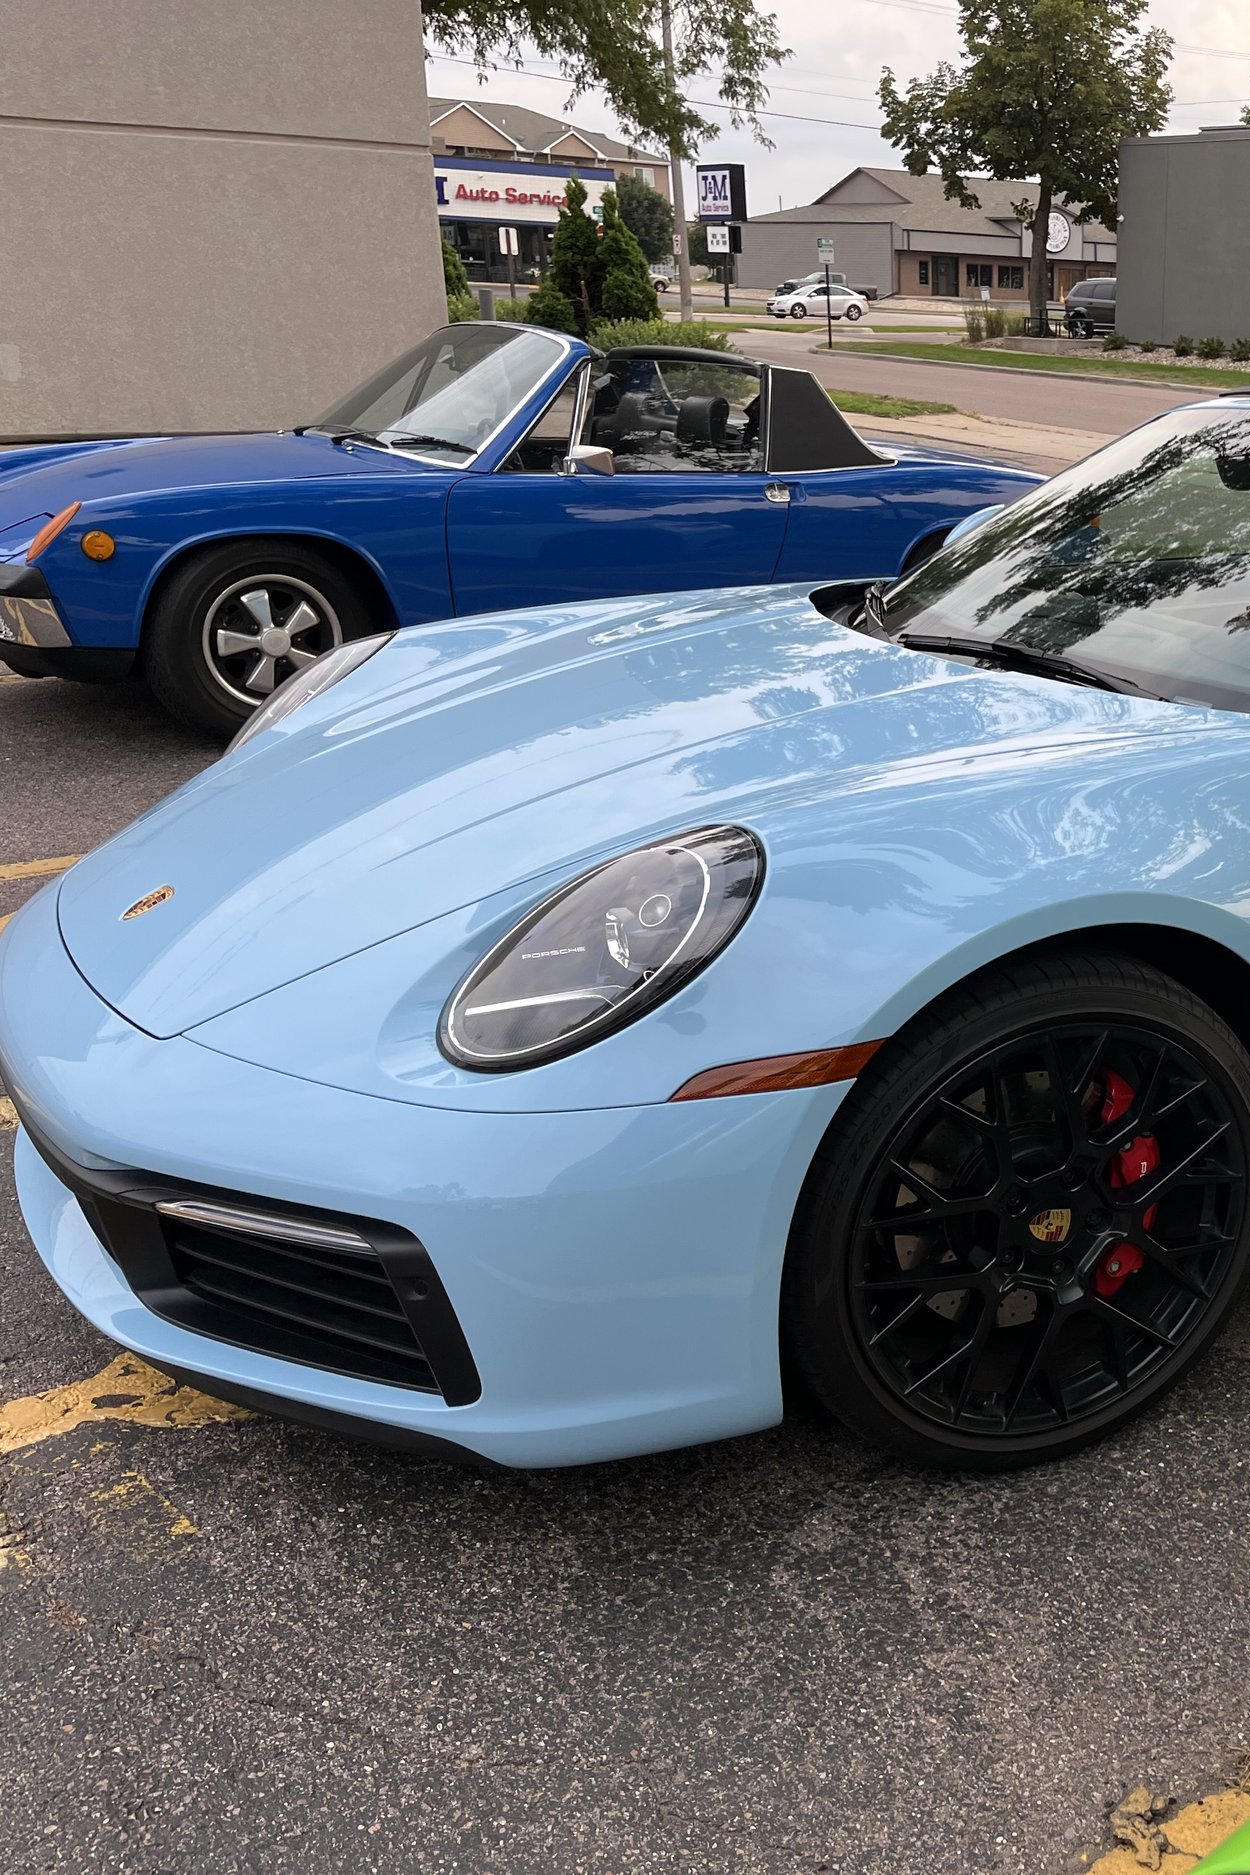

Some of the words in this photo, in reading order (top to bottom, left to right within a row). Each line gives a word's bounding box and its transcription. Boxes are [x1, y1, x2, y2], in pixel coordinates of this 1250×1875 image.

[455, 184, 500, 203] Auto
[701, 174, 729, 201] J&M
[521, 946, 586, 960] PORSCHE
